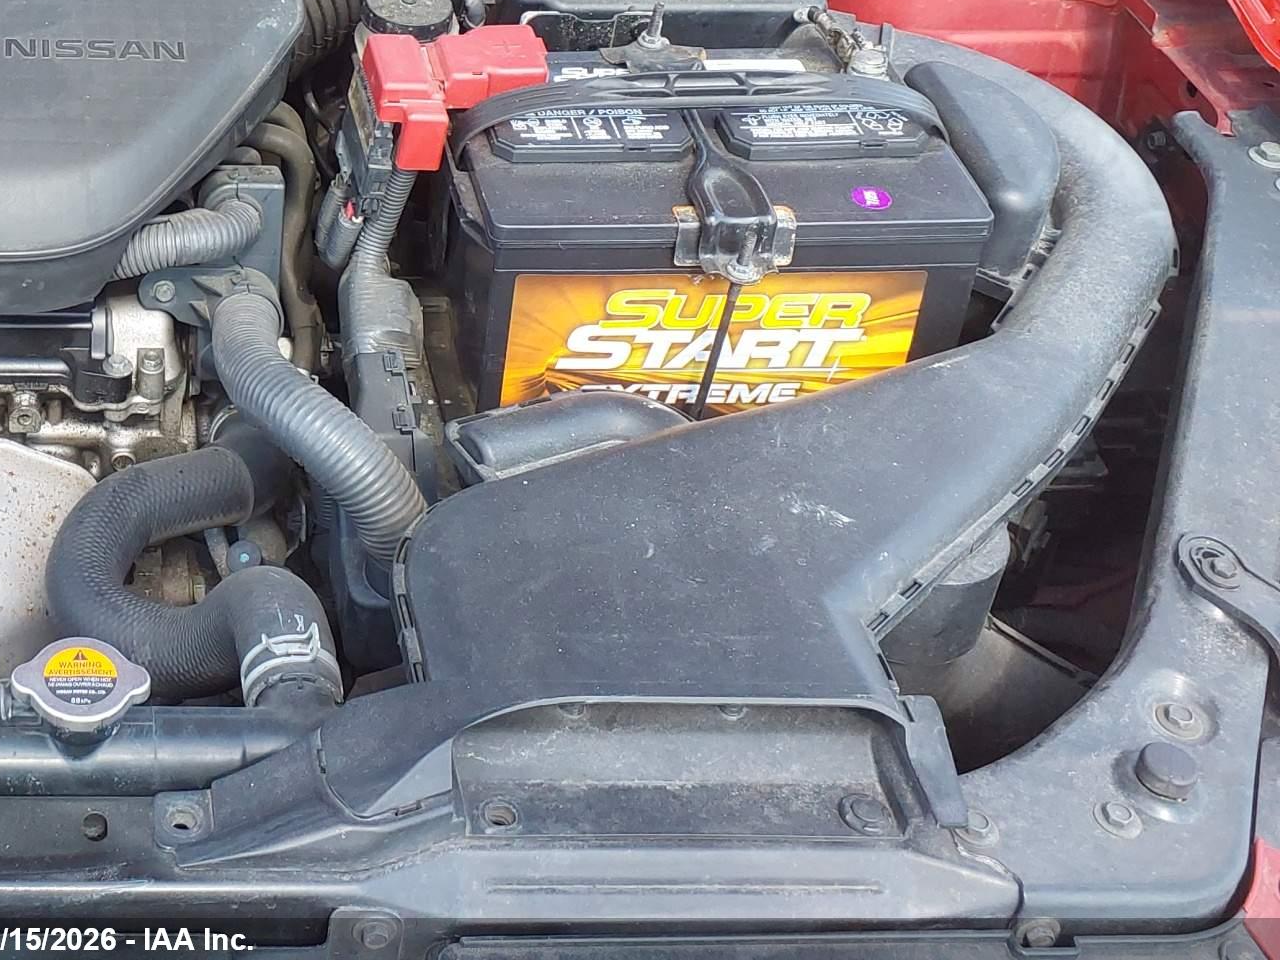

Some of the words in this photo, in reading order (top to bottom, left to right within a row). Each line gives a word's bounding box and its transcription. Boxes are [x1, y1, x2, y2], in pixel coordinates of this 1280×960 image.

[4, 38, 186, 61] NISSAN
[537, 109, 586, 117] DANGER
[598, 108, 643, 116] POISON
[599, 289, 871, 329] SUPER
[554, 325, 866, 370] START
